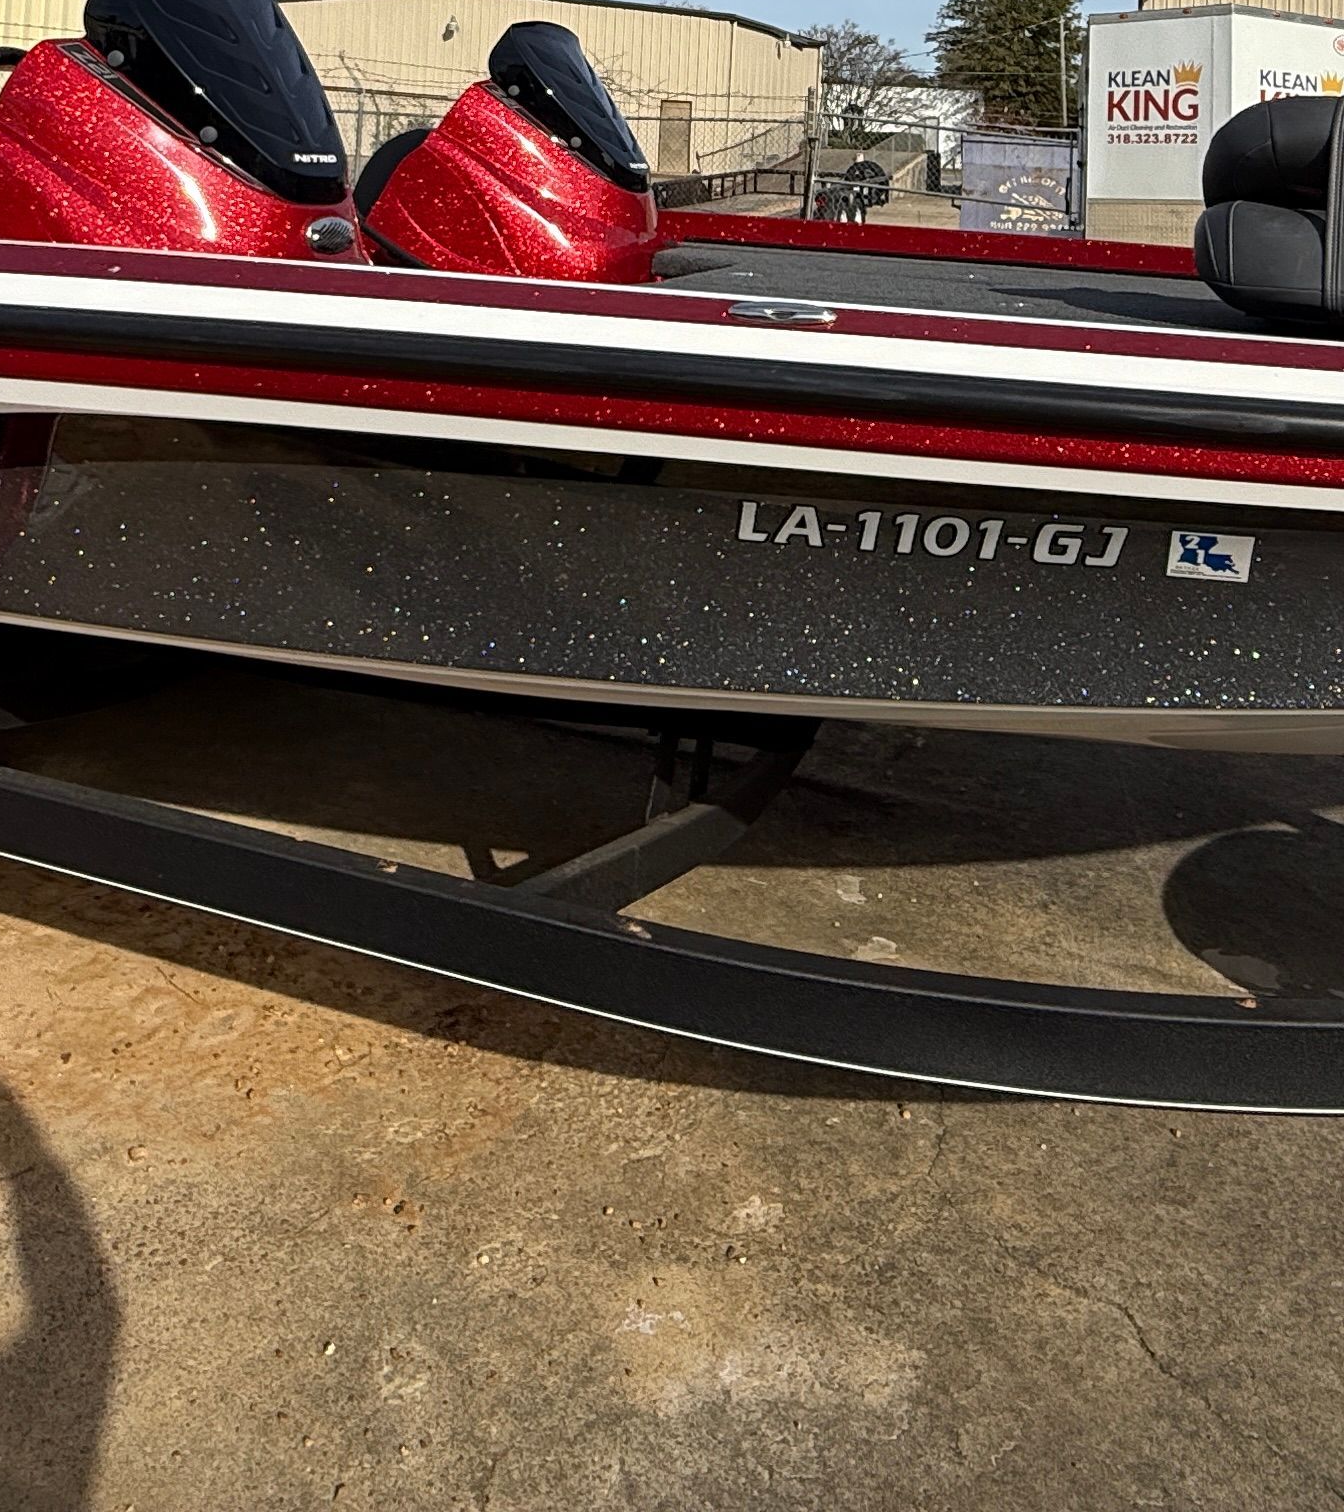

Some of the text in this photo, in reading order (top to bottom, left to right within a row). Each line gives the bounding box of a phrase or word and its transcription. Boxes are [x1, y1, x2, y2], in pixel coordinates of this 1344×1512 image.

[1108, 69, 1171, 88] KLEAN
[1260, 69, 1317, 93] KLEAN
[1107, 88, 1199, 122] KING
[1107, 133, 1198, 145] 318.323.8722
[738, 501, 1129, 567] LA-1101-GJ
